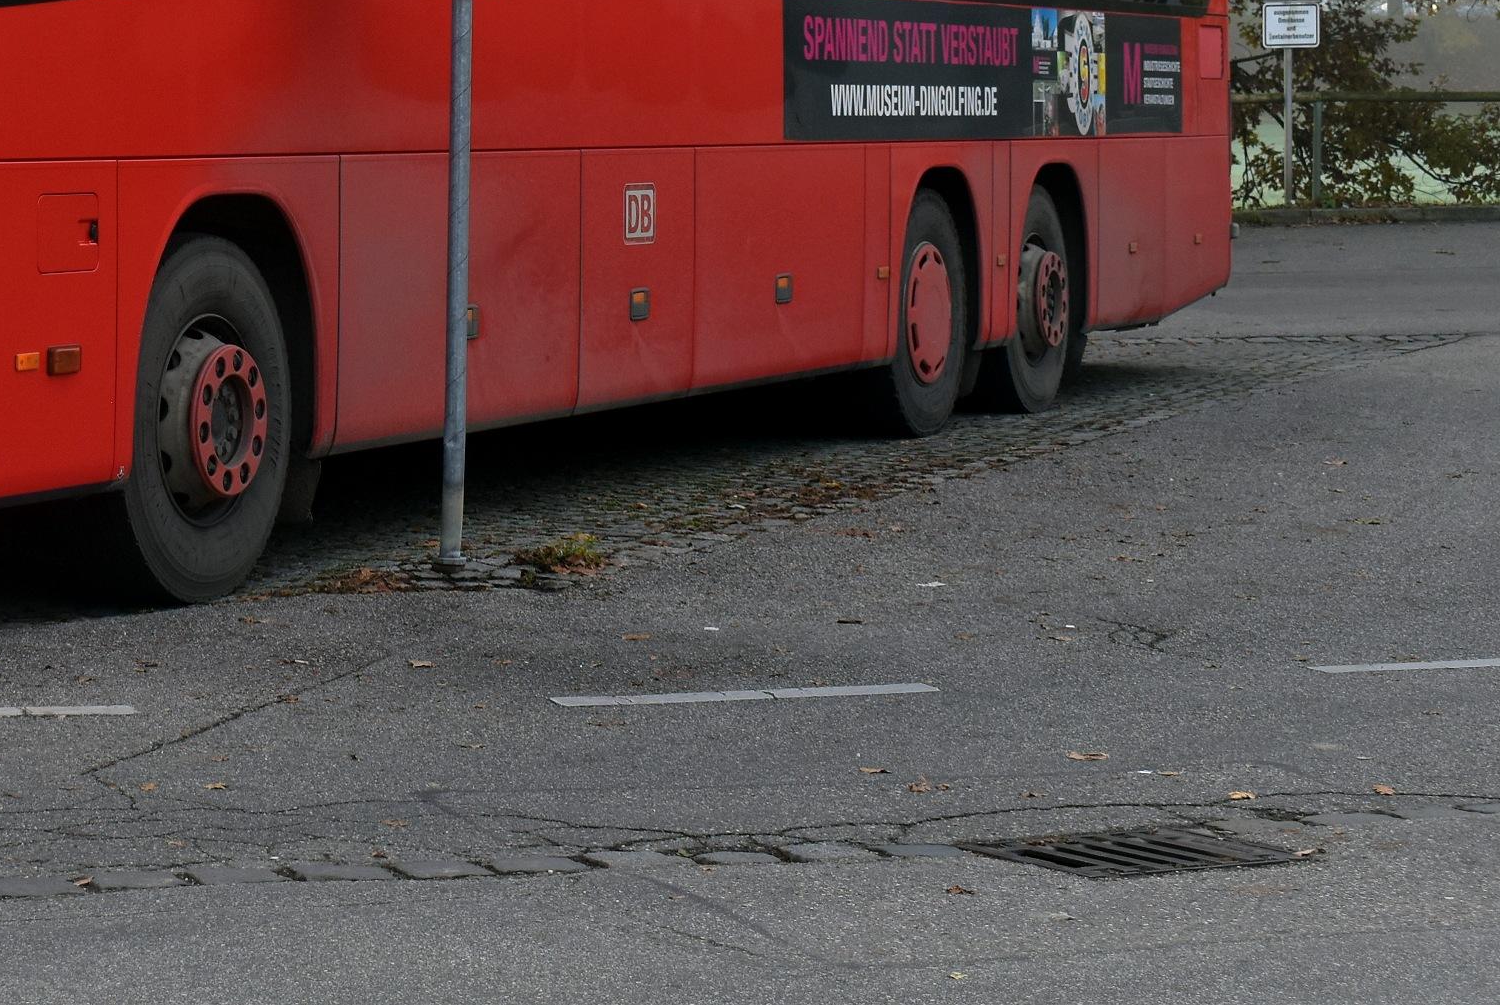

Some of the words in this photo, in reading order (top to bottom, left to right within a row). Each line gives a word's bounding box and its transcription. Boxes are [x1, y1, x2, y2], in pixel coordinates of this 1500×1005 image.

[803, 14, 889, 63] SPANNEND
[893, 20, 937, 65] STATT
[941, 24, 1019, 67] VERSTAUBT
[1123, 42, 1141, 105] M
[831, 84, 998, 117] WWW.MUSEUM-DINGOLFING.DE
[627, 193, 652, 234] DB
